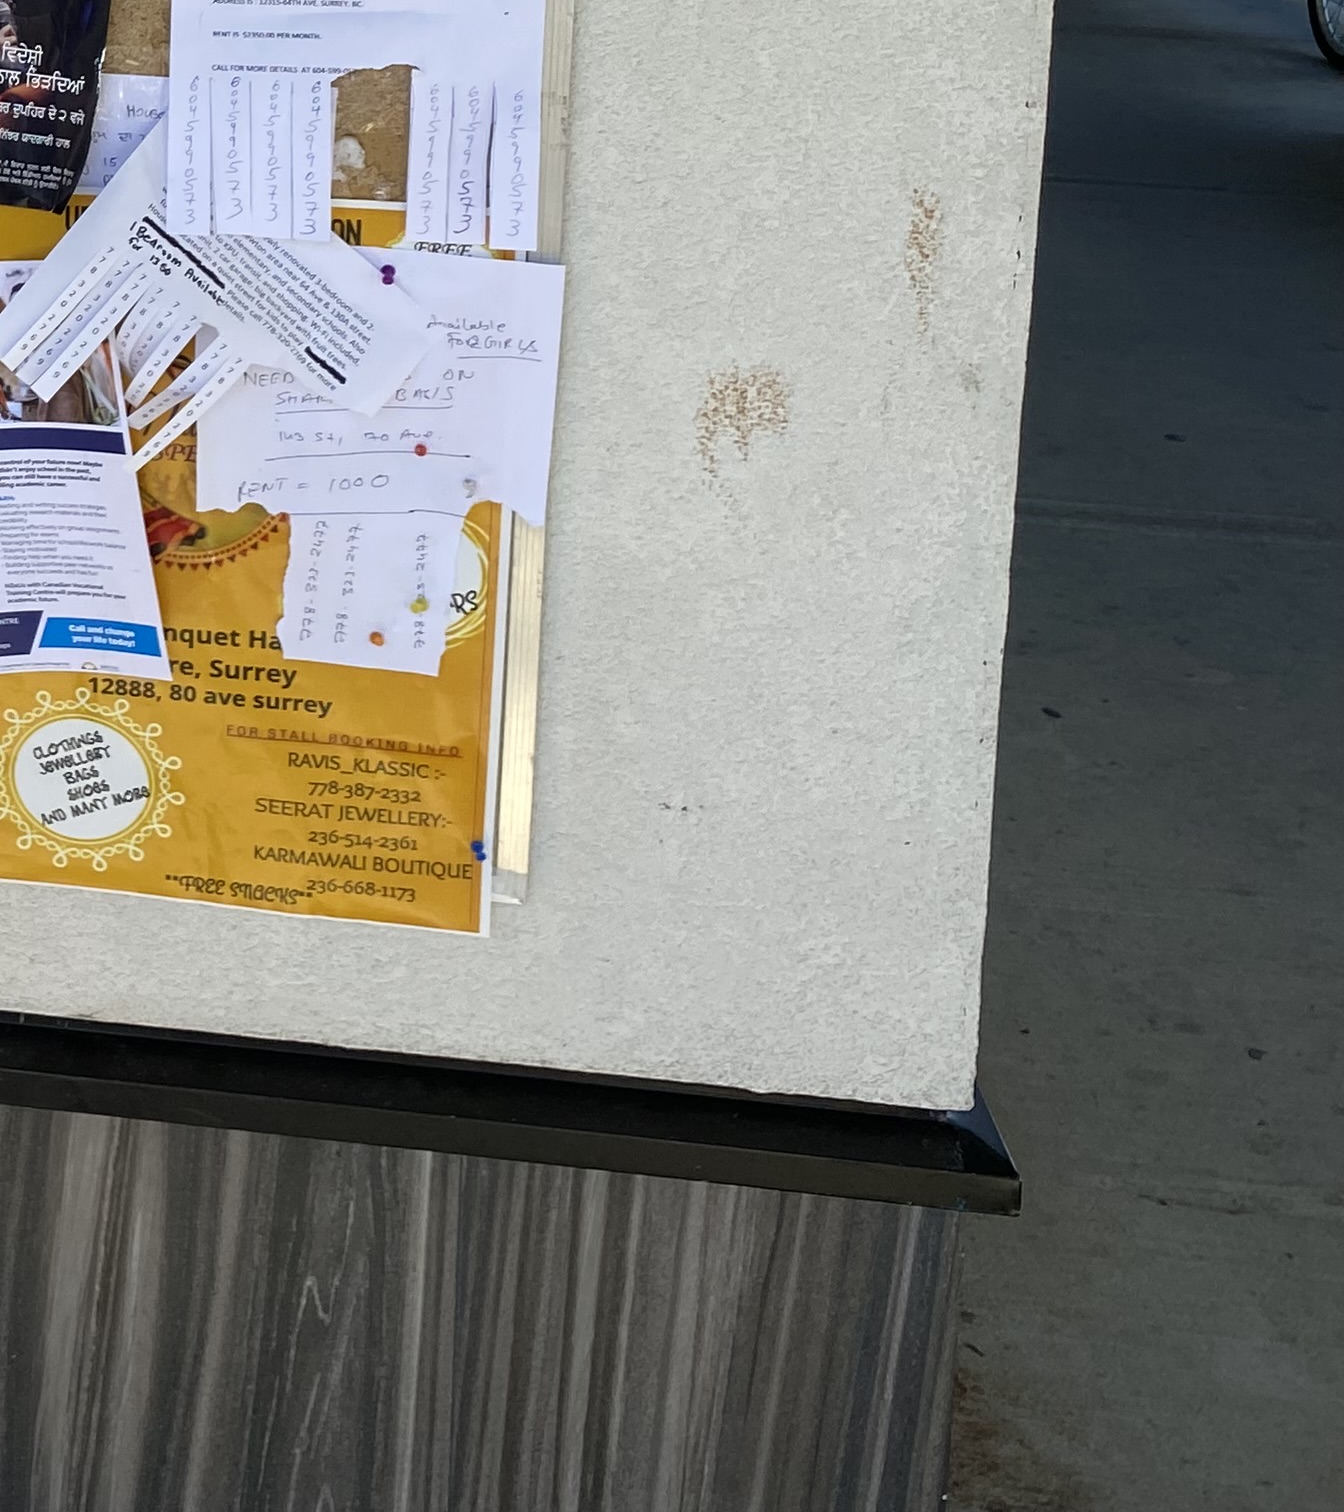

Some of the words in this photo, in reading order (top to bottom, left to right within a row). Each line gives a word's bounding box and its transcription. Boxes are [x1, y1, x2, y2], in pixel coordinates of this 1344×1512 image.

[209, 660, 297, 688] Surrey
[88, 677, 162, 702] 12888,
[169, 685, 196, 701] 80
[203, 692, 245, 707] ave
[253, 694, 332, 718] surrey
[288, 752, 430, 778] RAVIS_KLASSIC
[308, 781, 421, 803] 778-387-2332
[255, 798, 334, 819] SEERAT
[308, 830, 418, 850] 236-514-2361
[254, 845, 366, 870] KARMAWALI
[372, 857, 473, 880] BOUTIQUE
[307, 879, 416, 901] 236-668-1173
